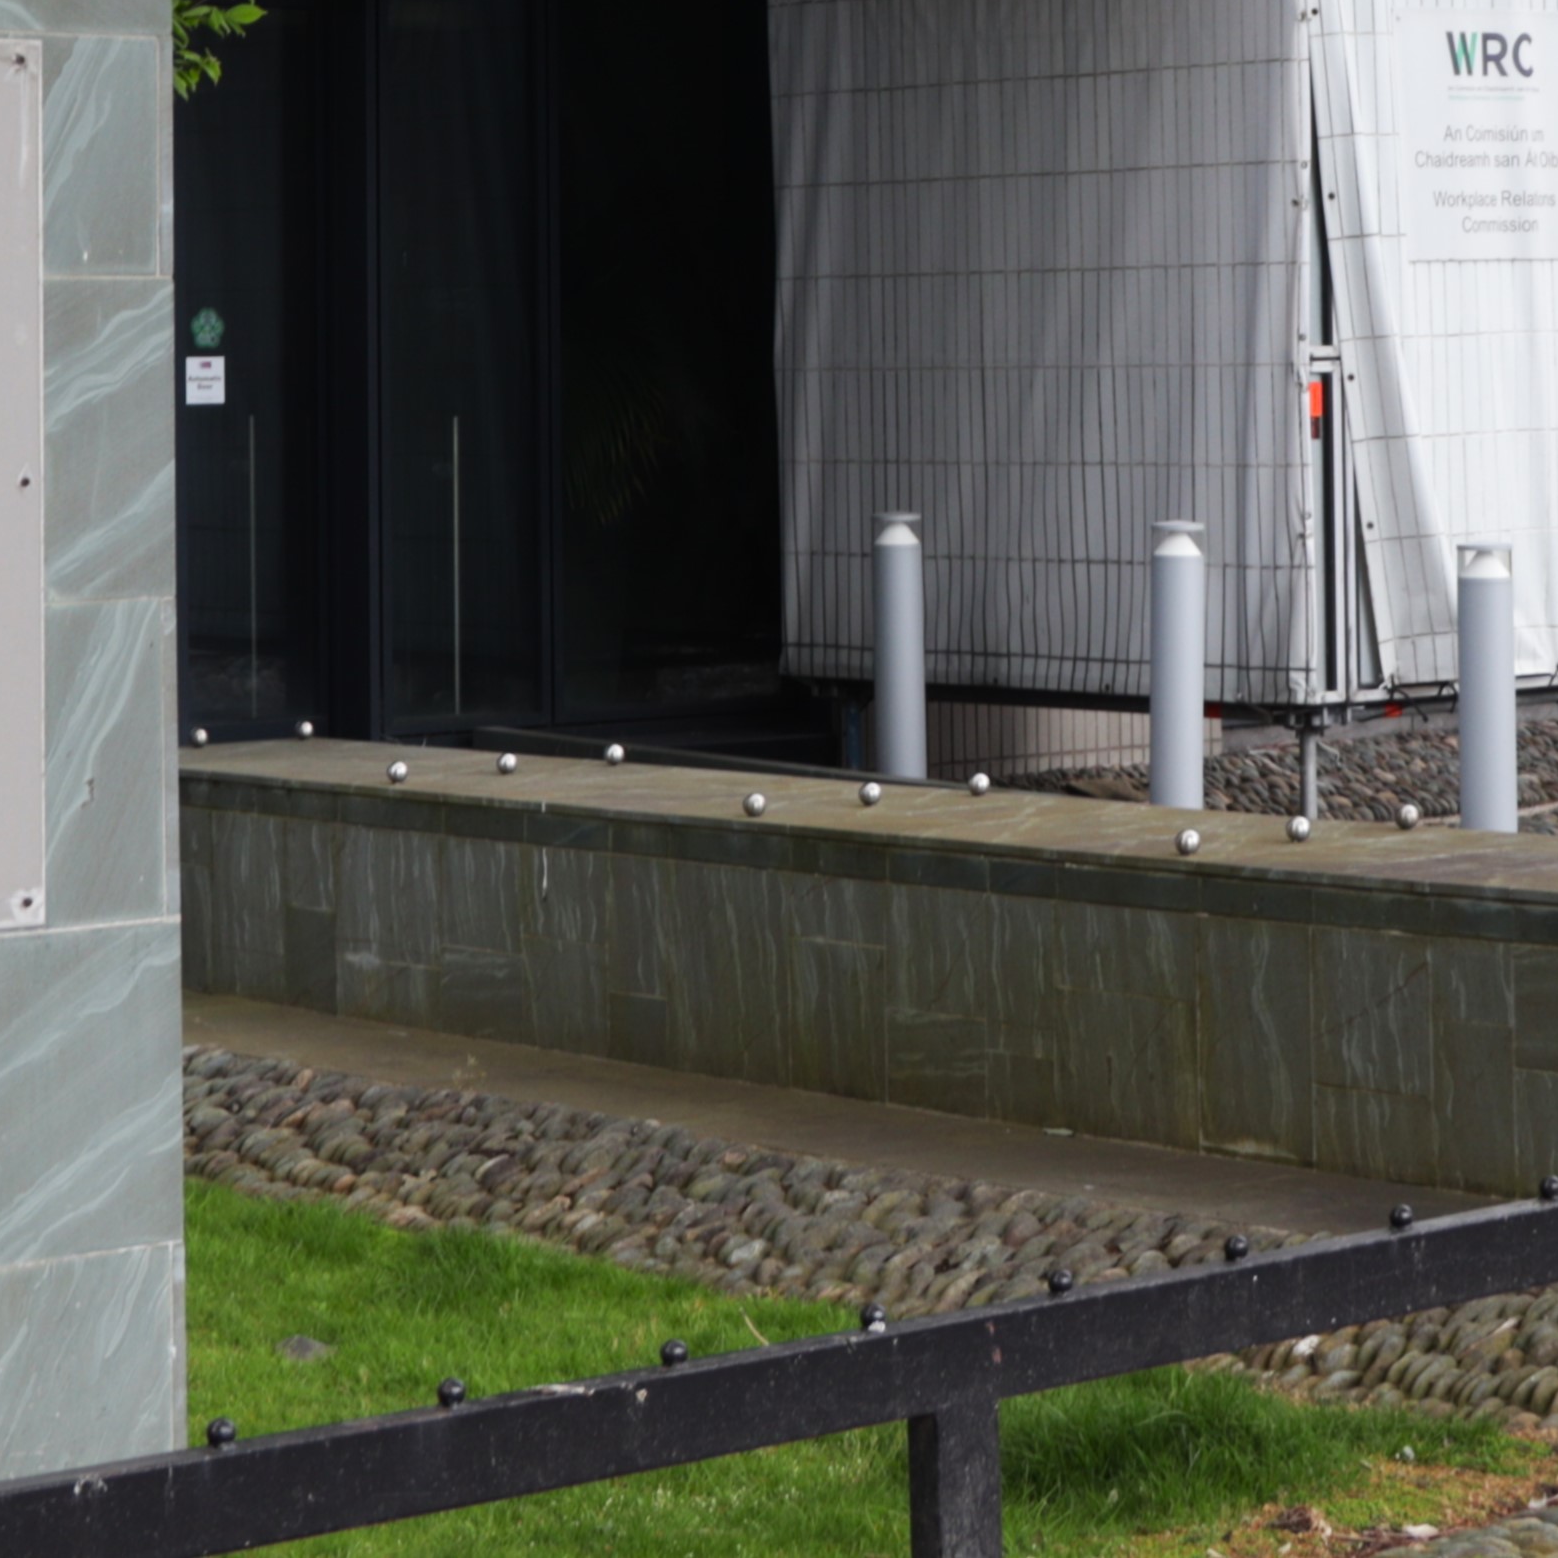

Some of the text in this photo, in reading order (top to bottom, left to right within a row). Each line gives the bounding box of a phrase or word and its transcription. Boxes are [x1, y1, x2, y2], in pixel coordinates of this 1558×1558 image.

[1445, 30, 1534, 78] WRC
[1443, 124, 1462, 143] An
[1494, 153, 1520, 169] san
